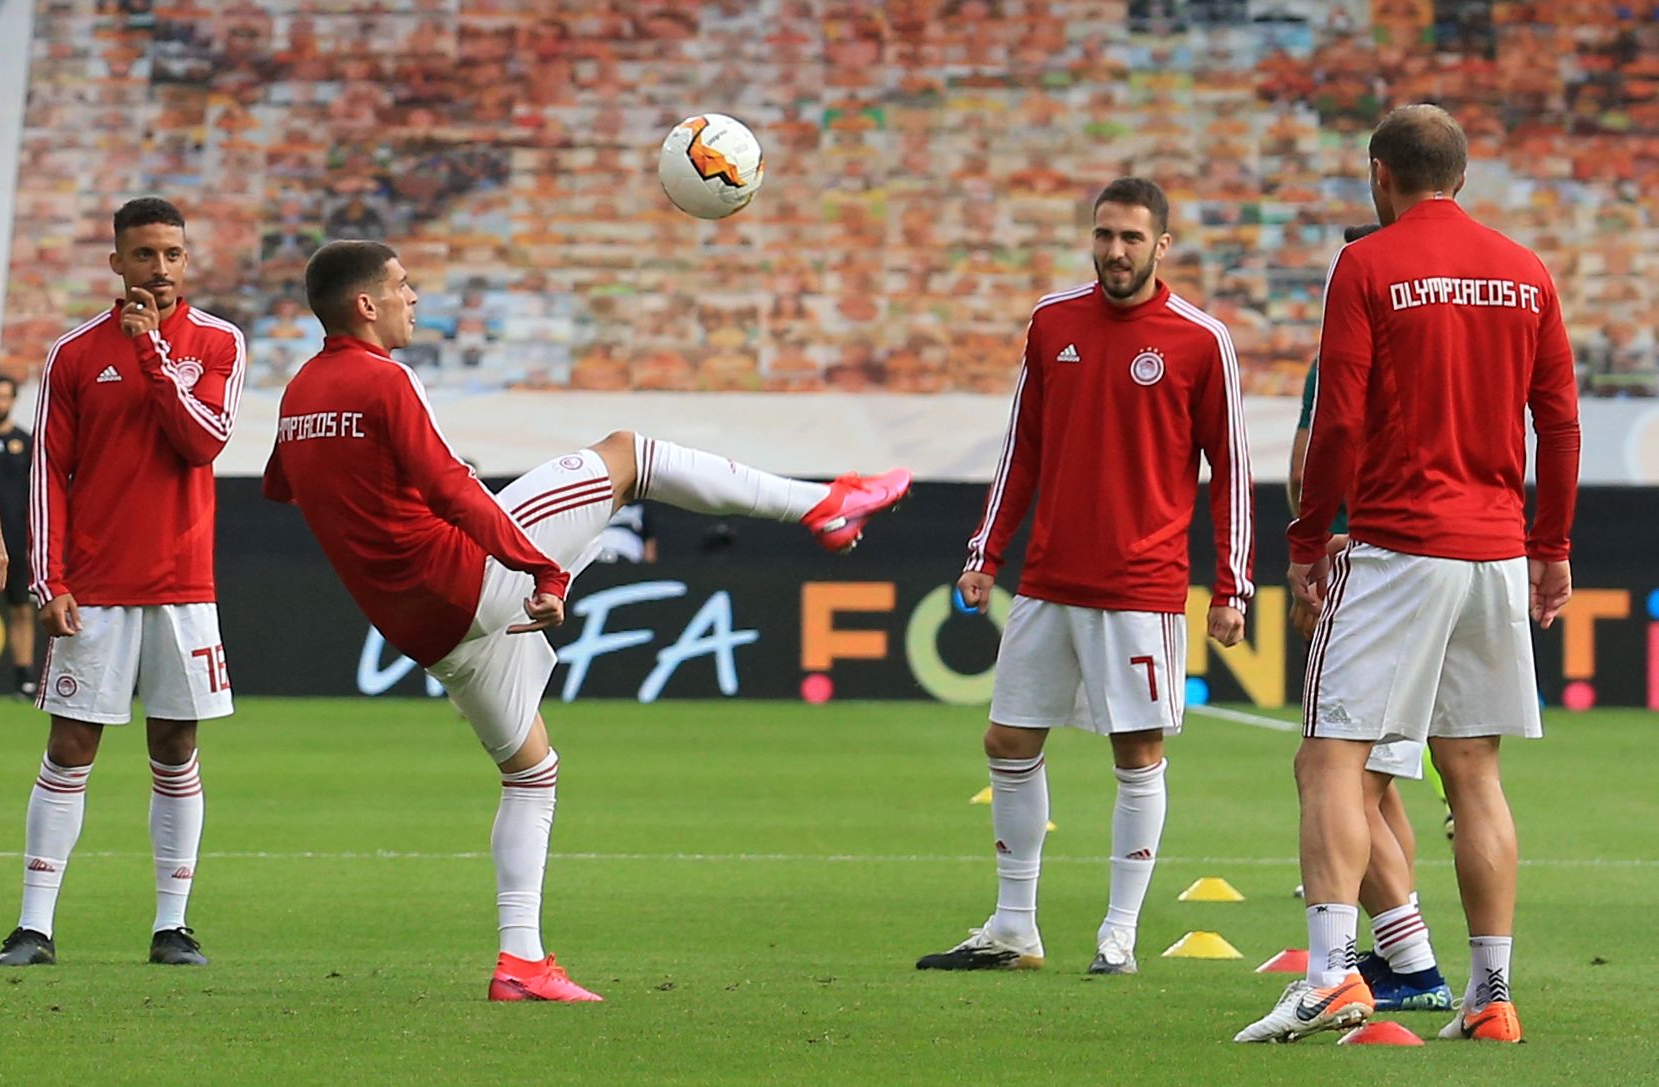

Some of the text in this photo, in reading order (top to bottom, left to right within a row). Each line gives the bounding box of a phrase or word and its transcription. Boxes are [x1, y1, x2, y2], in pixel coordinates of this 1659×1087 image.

[1390, 277, 1540, 314] OLYMPIACOS FC
[278, 412, 365, 444] MPIACOS FC
[1130, 655, 1159, 702] 7
